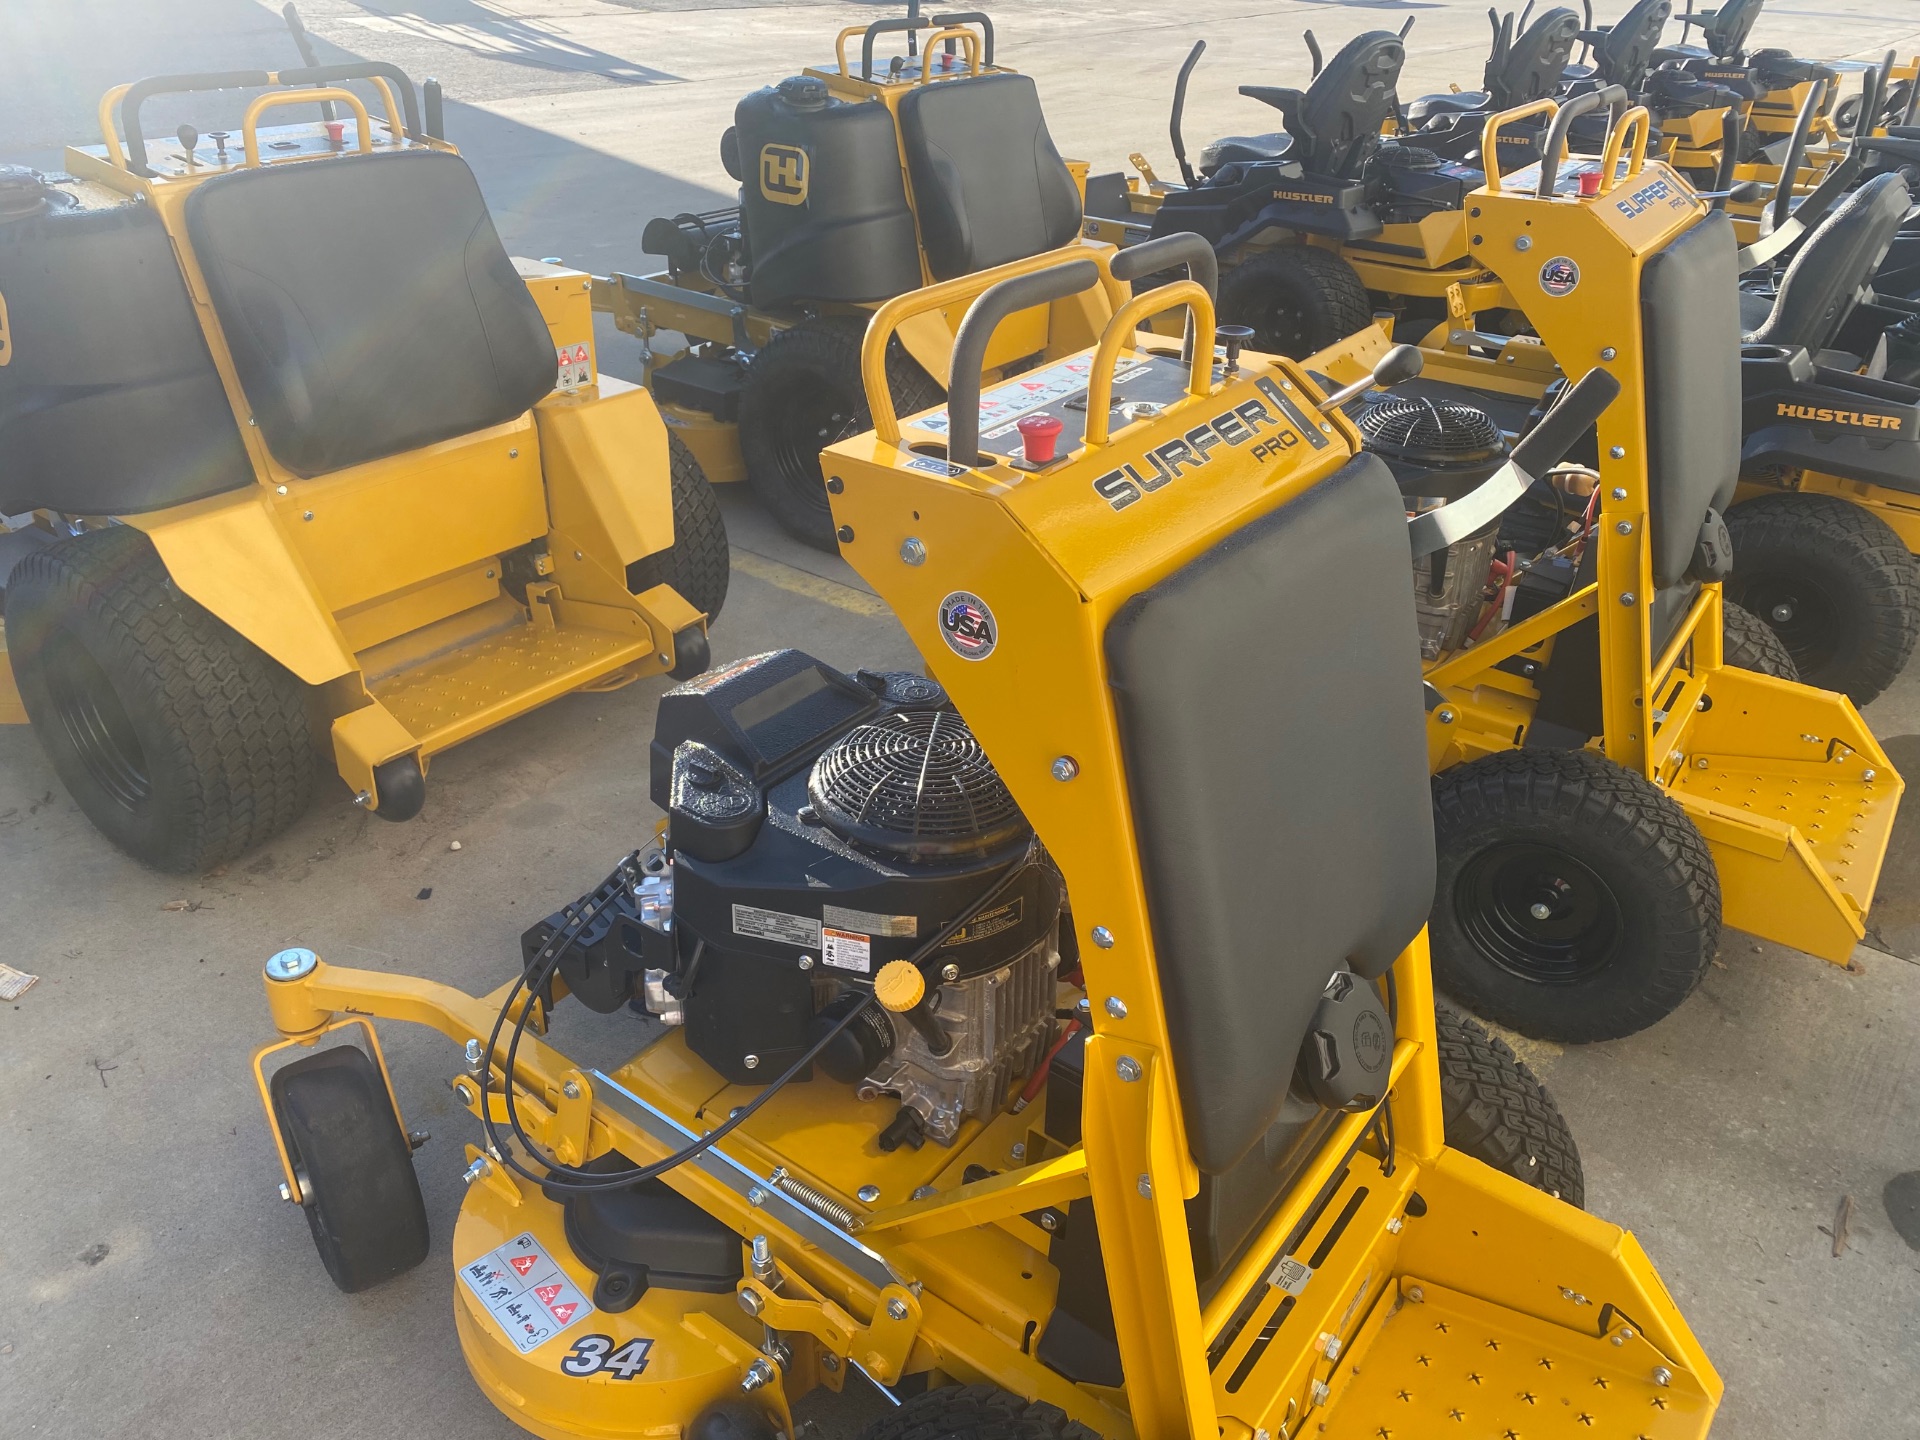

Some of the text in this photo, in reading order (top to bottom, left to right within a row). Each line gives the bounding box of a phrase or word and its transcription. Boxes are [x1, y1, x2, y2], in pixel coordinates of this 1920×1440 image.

[1479, 134, 1530, 145] STLER
[1273, 190, 1334, 204] HUSTLER
[1616, 179, 1675, 219] SURFER
[1668, 196, 1687, 211] PRO
[1542, 268, 1576, 285] USA
[1777, 403, 1902, 430] HUSTLER
[1092, 398, 1281, 512] SURFER
[1250, 429, 1299, 463] PRO
[945, 595, 991, 621] MADE IN THE
[942, 607, 994, 645] USA
[738, 926, 765, 937] Kawasaki
[835, 931, 866, 942] WARNING
[561, 1334, 655, 1381] 34
